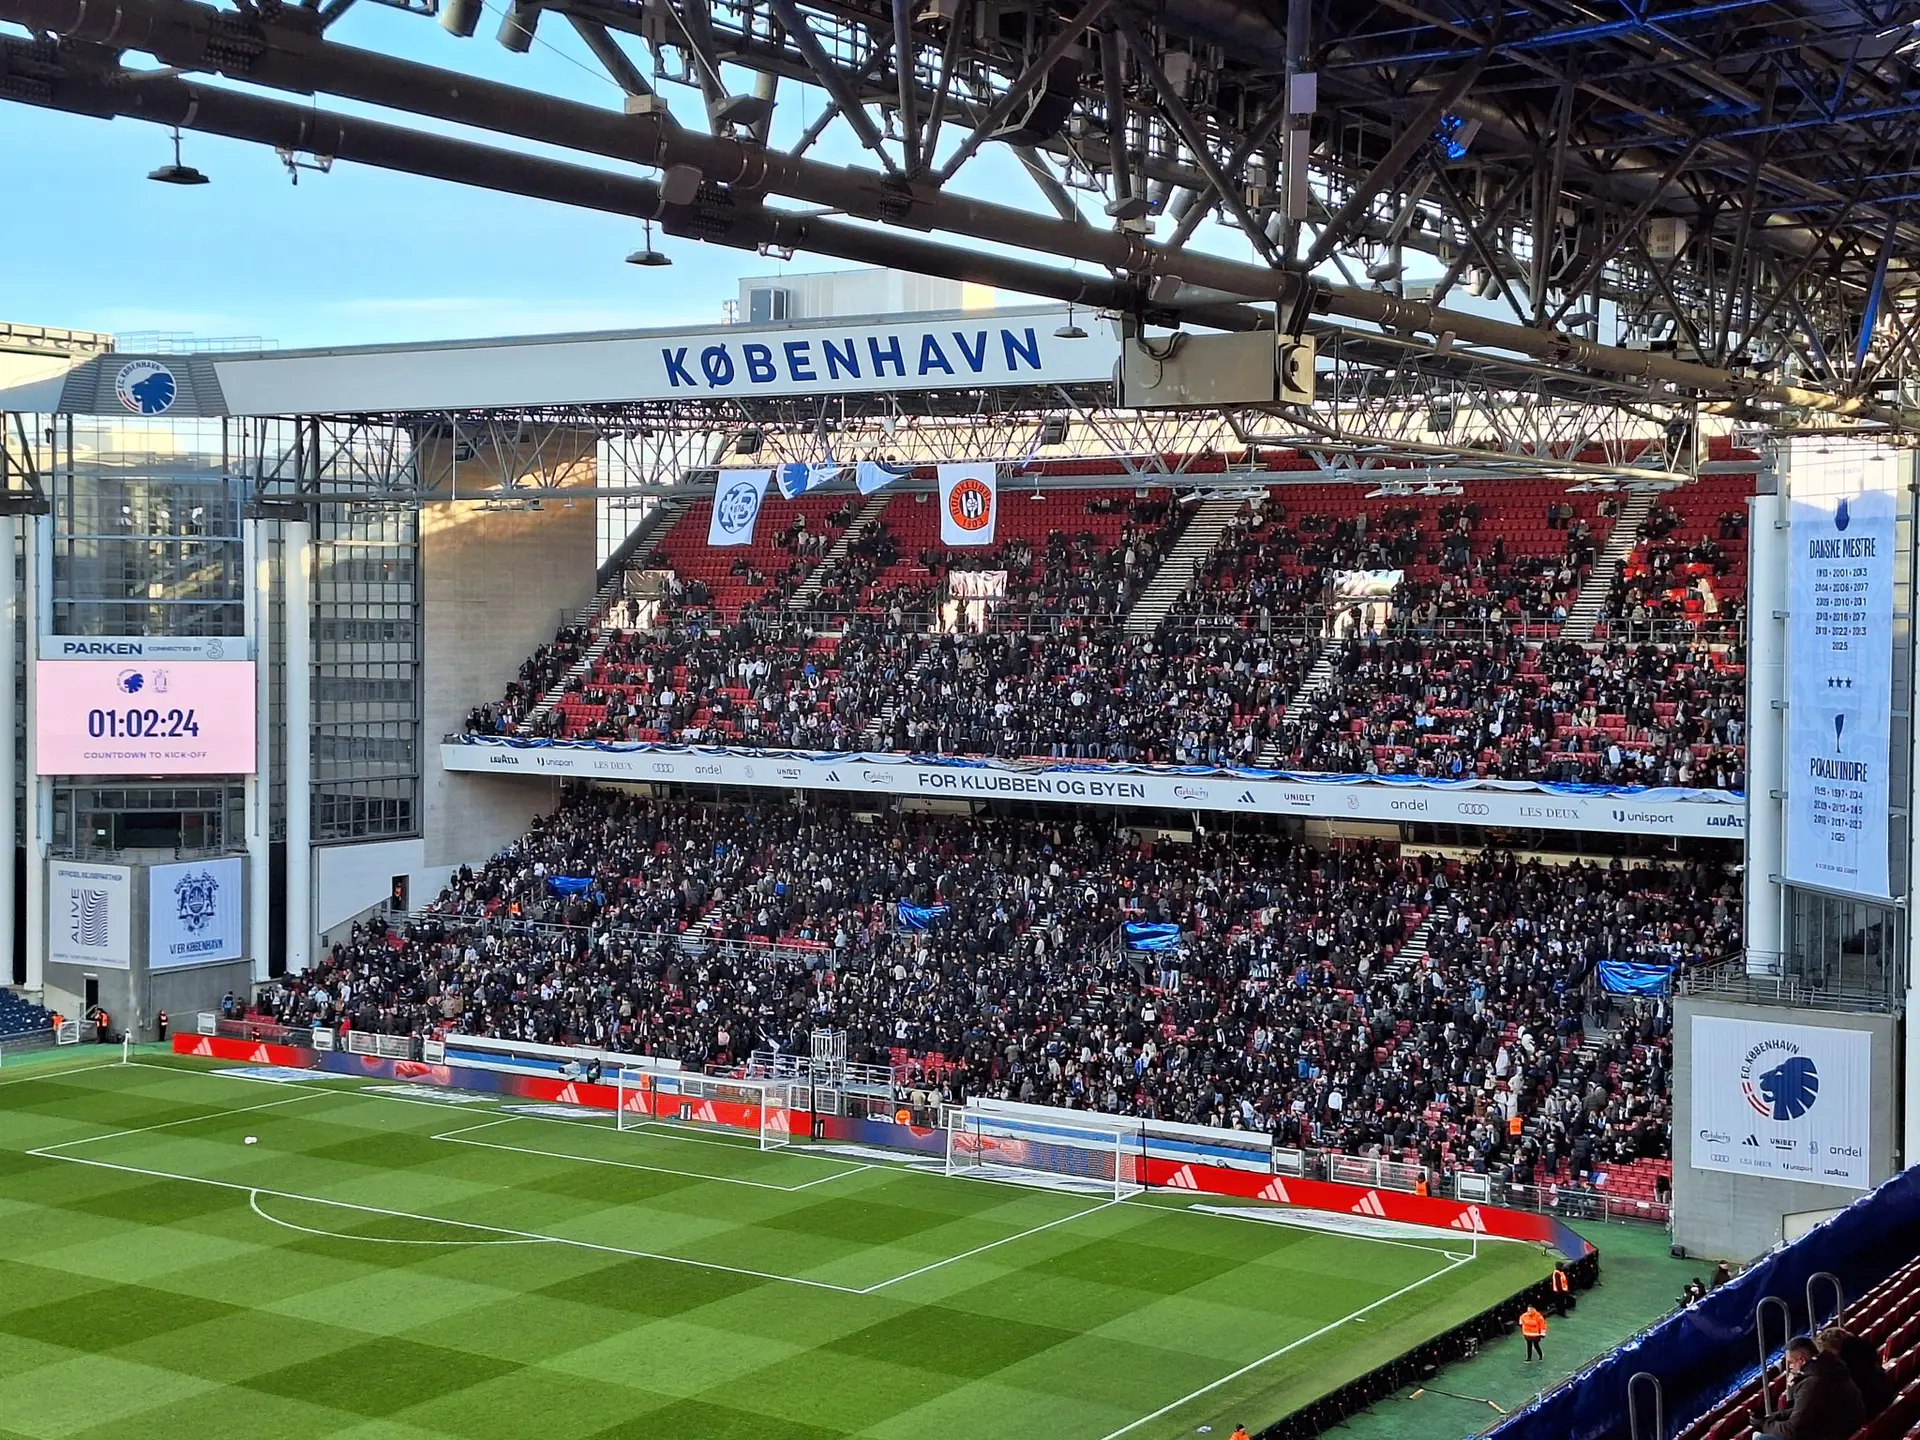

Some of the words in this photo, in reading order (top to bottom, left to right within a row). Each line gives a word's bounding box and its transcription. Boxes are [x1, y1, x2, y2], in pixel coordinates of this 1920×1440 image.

[661, 328, 1042, 389] KØBENHAVN
[962, 517, 984, 528] 1903
[1809, 539, 1841, 558] DANSKE
[1842, 538, 1876, 558] MESTRE
[1833, 568, 1848, 578] 2001
[63, 642, 142, 655] PARKEN
[88, 709, 199, 737] 01:02:24
[84, 751, 146, 759] COUNTDOWN
[594, 761, 608, 769] LES
[611, 763, 632, 771] DEUX
[695, 765, 722, 775] andel
[918, 774, 956, 788] FOR
[961, 776, 1051, 793] KLUBBEN
[1056, 780, 1086, 795] OG
[1090, 782, 1145, 798] BYEN
[1284, 793, 1315, 802] UNIBET
[1391, 800, 1428, 811] andel
[1519, 806, 1542, 818] LES
[1546, 808, 1580, 819] DEUX
[1627, 811, 1674, 824] unisport
[1707, 814, 1745, 827] LAVAZ
[71, 888, 79, 944] ALIVE
[177, 943, 186, 954] ER
[1745, 1040, 1800, 1068] KØBENHAVN
[1700, 1130, 1731, 1143] Carlsberg
[1770, 1137, 1797, 1147] UNIBET
[1829, 1146, 1862, 1157] andel
